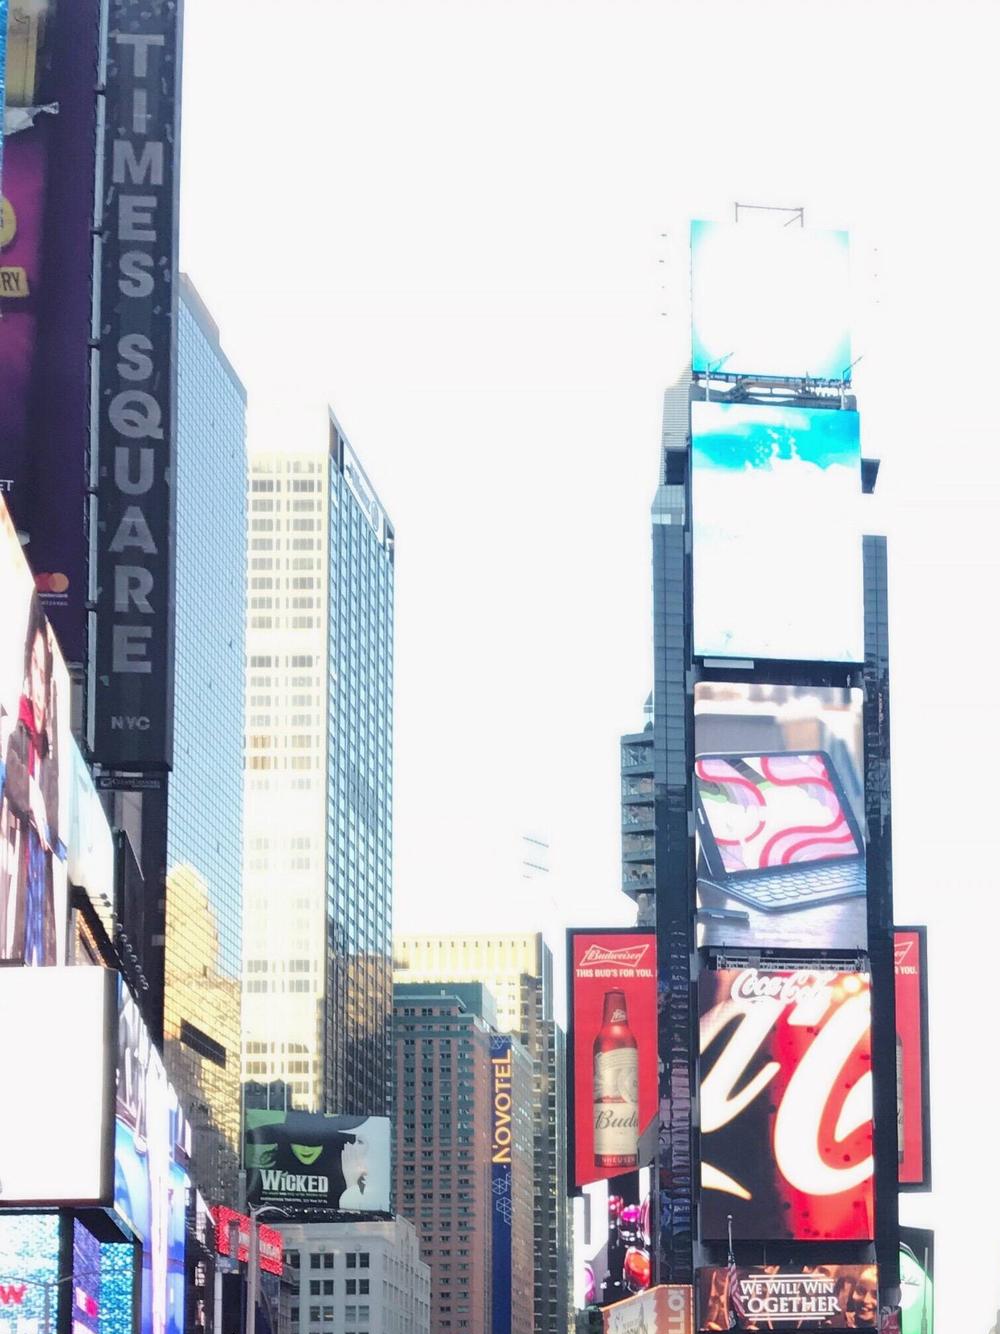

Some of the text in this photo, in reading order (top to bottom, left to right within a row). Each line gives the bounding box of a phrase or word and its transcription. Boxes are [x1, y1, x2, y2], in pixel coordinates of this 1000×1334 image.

[112, 34, 165, 297] TIMES
[108, 333, 165, 674] SQUARE
[111, 716, 150, 730] NYC
[585, 949, 641, 961] Budweiser
[576, 969, 593, 977] THIS
[620, 968, 634, 977] FOR
[492, 1049, 512, 1163] NOVOTEL
[741, 1280, 834, 1295] WE WILL WIN
